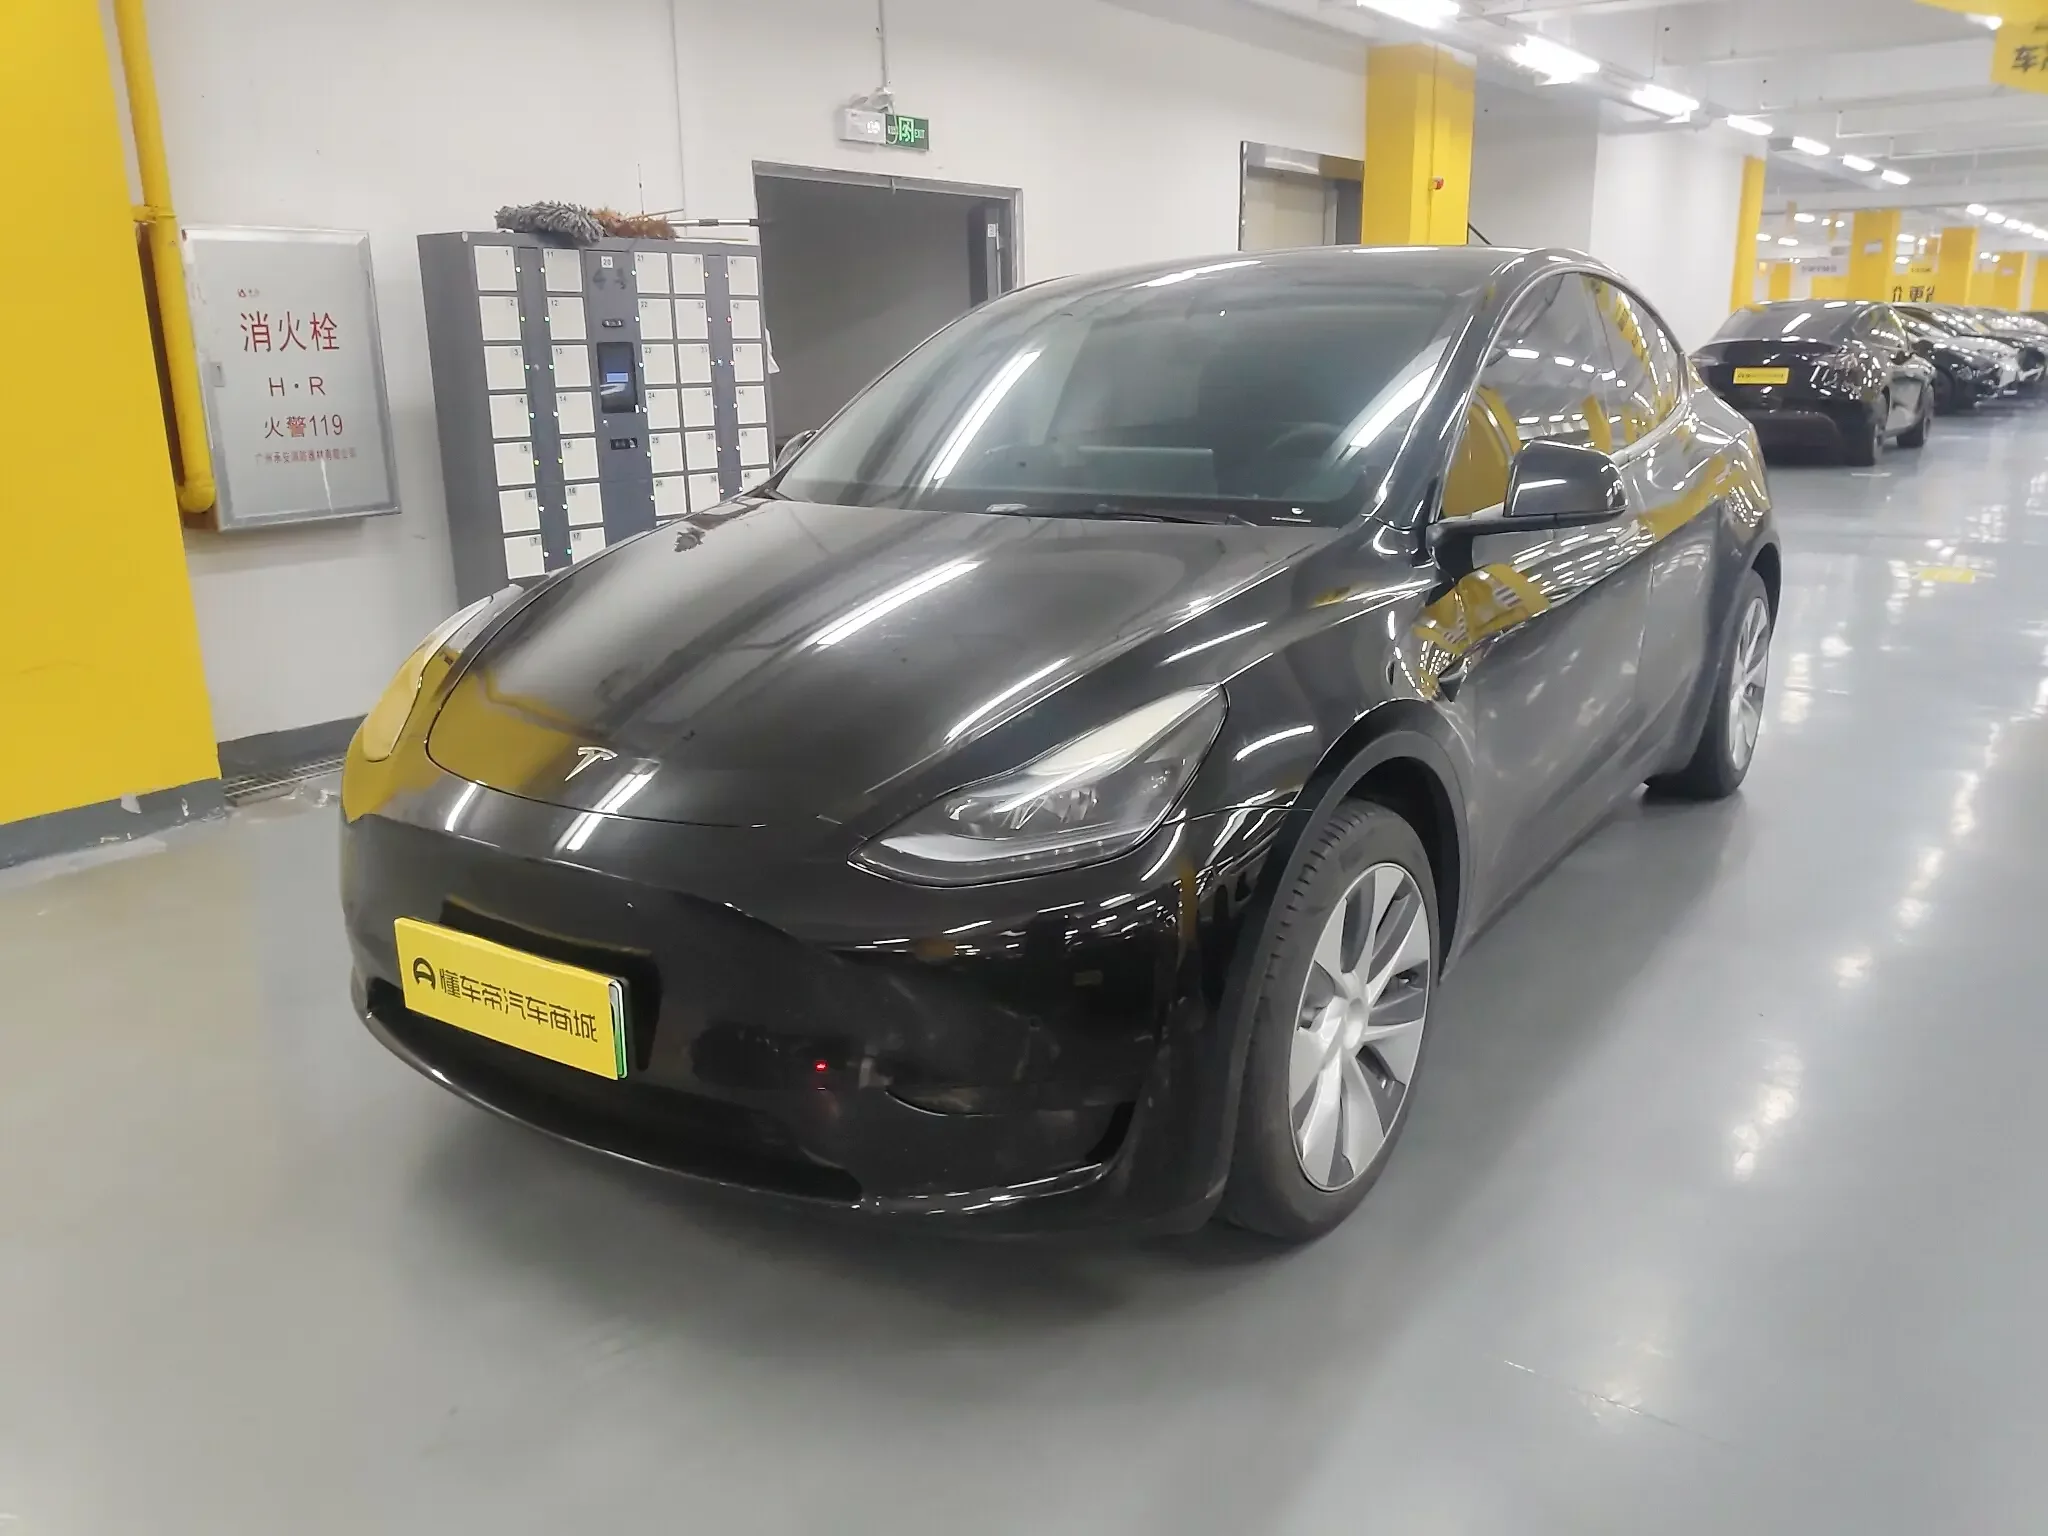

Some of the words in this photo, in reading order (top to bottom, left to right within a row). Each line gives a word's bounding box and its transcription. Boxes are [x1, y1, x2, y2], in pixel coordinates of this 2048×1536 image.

[240, 310, 340, 353] 消火栓
[264, 414, 344, 439] 火警119
[439, 968, 598, 1043] 懂车帝汽车商城
